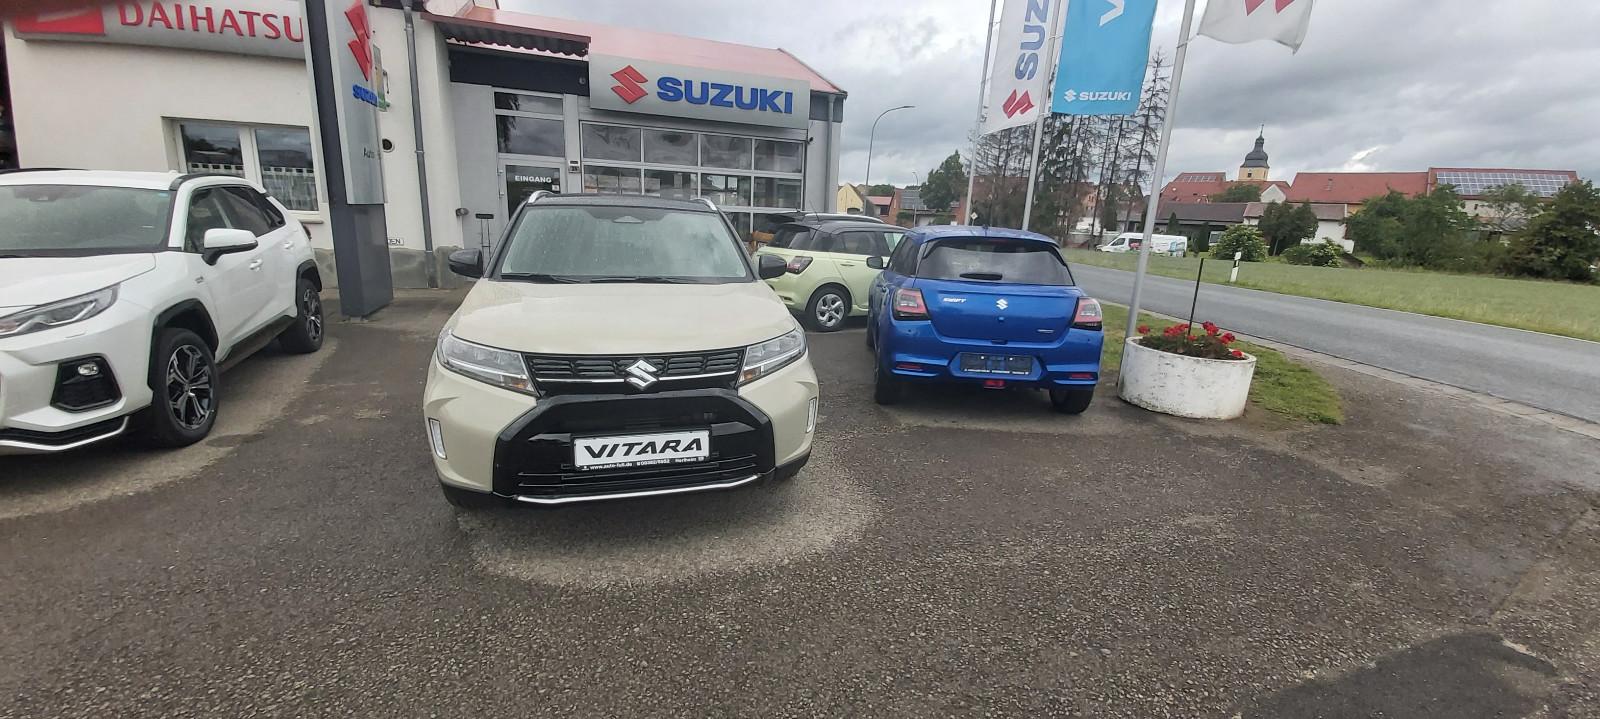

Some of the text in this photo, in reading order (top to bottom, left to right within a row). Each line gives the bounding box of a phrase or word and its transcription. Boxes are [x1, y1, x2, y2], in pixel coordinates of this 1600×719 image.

[117, 1, 304, 43] DAIHATSU
[656, 76, 793, 115] SUZUKI
[1079, 91, 1132, 101] SUZUKI
[514, 175, 552, 183] EINGANG
[583, 437, 702, 459] VITARA
